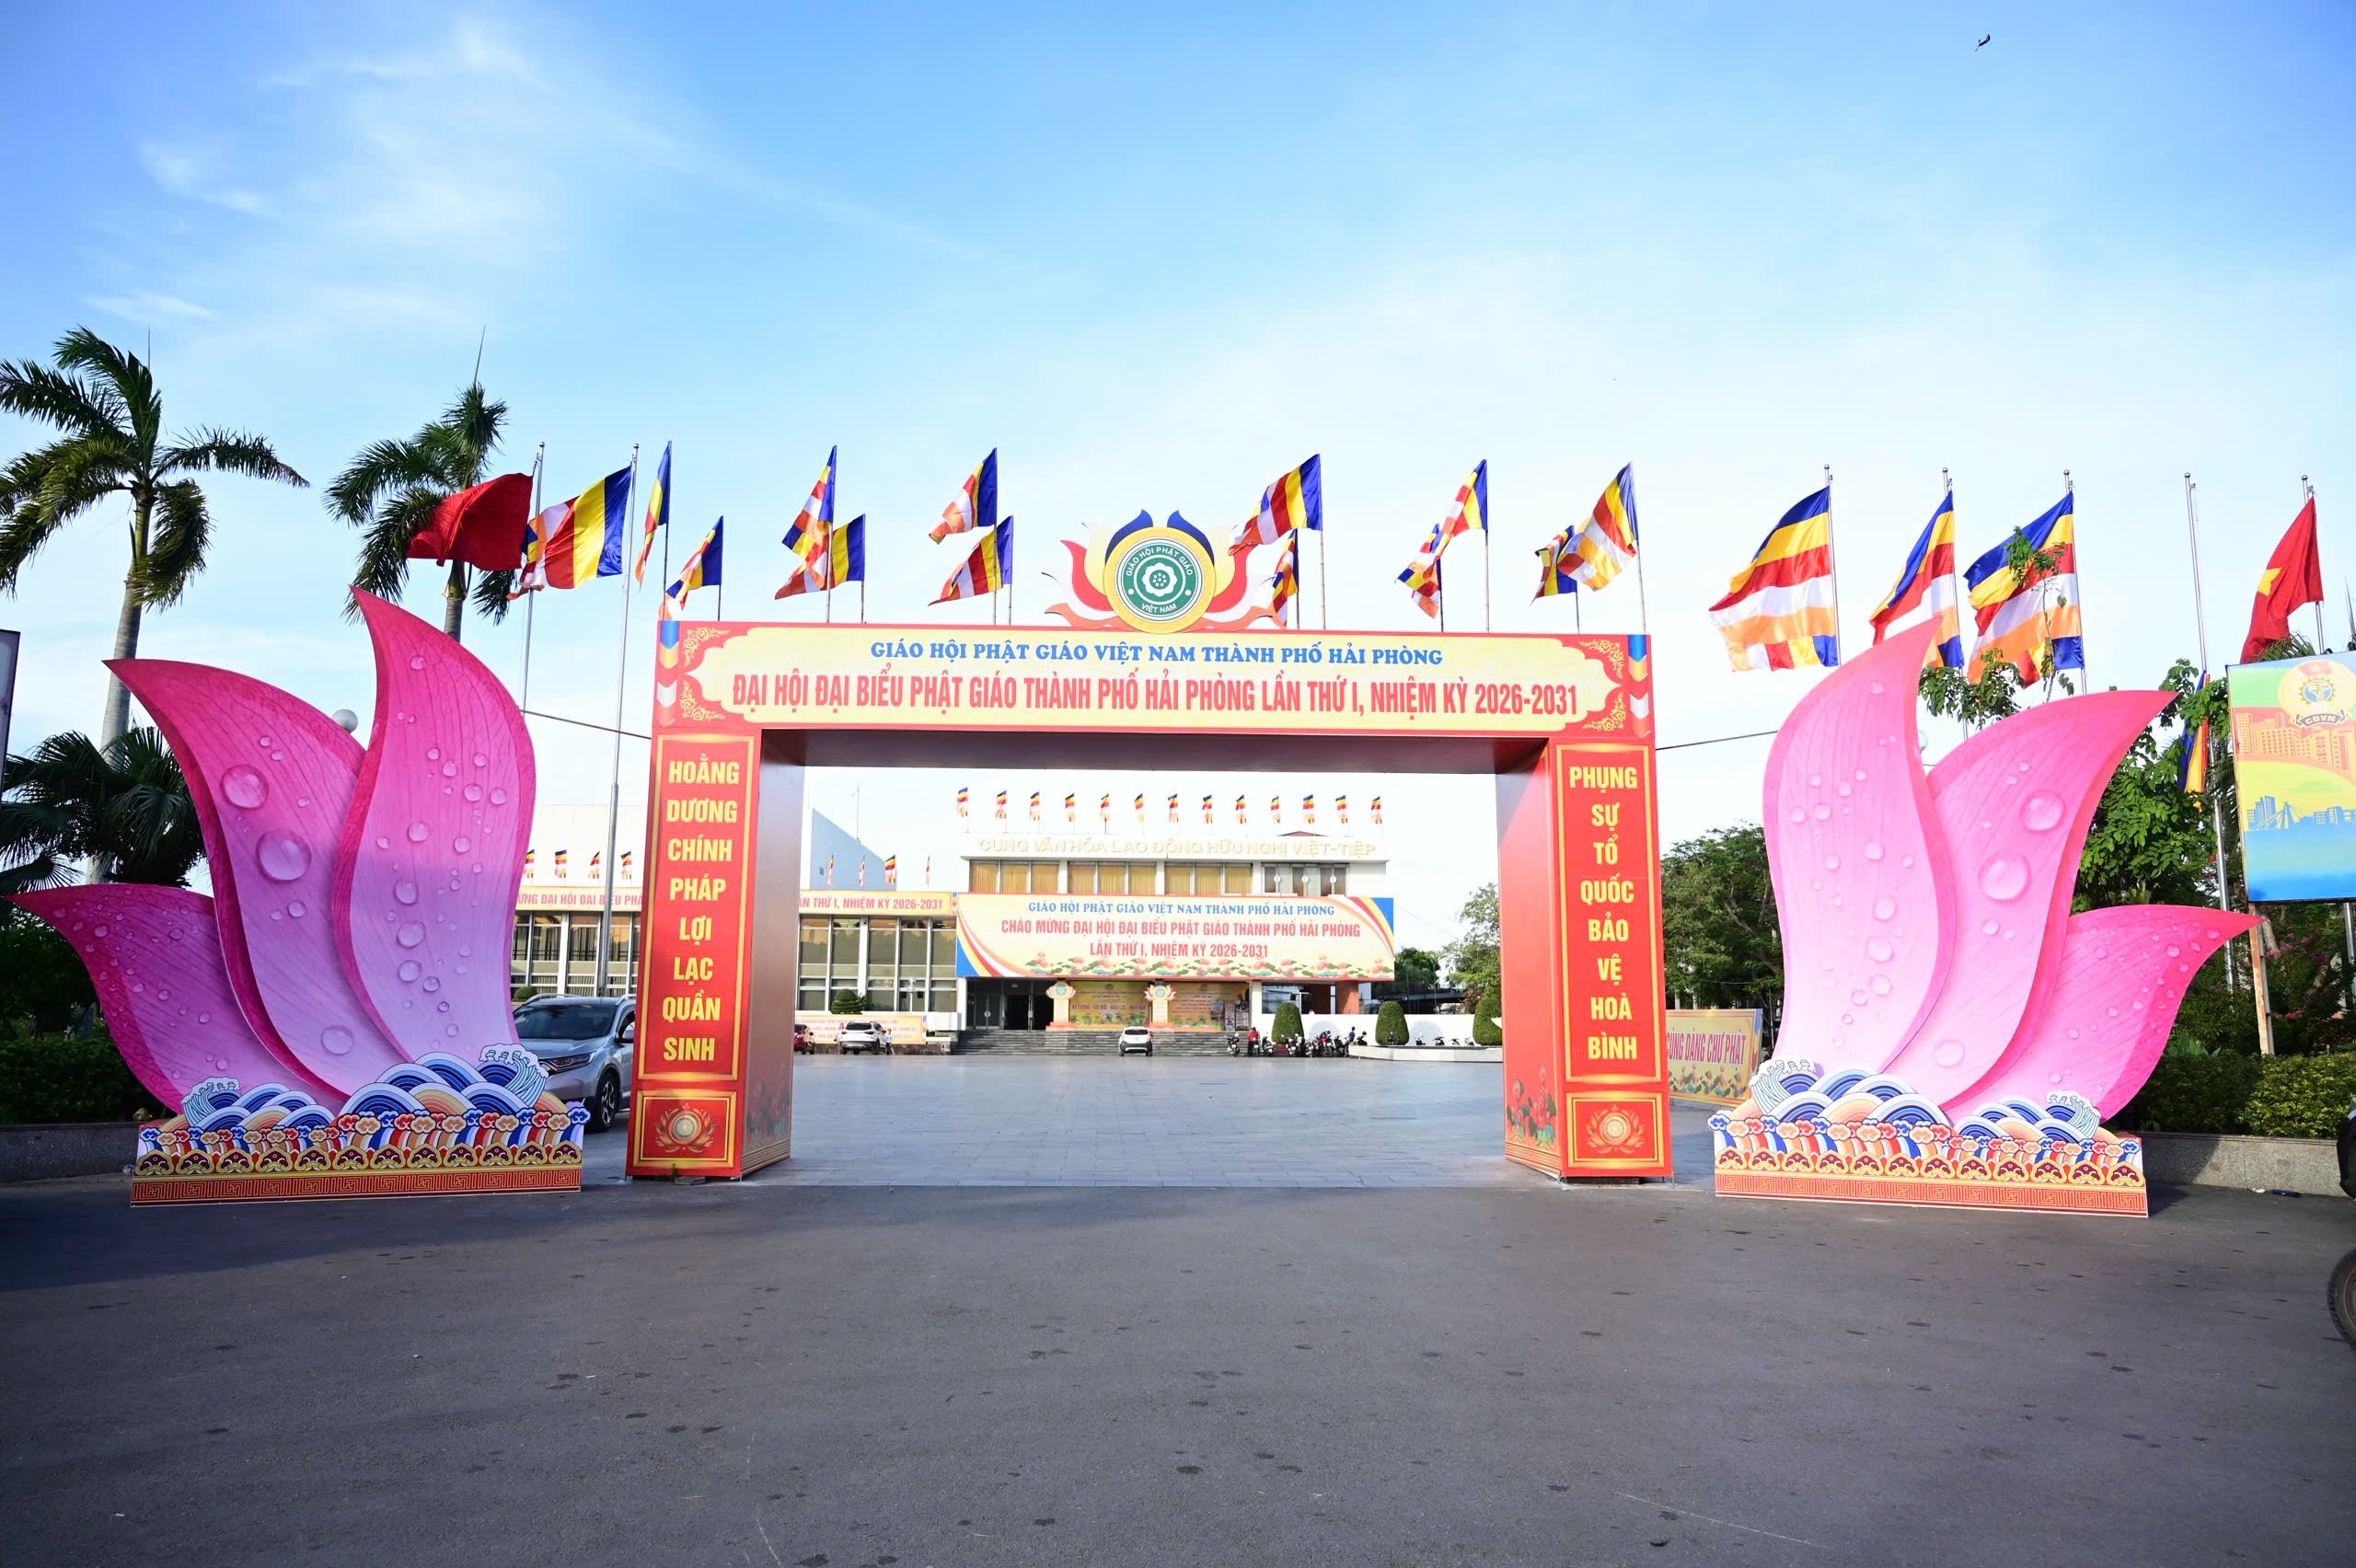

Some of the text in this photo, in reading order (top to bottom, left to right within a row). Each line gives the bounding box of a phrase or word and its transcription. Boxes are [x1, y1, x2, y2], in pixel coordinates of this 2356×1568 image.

[1126, 557, 1139, 576] GIÁO
[1138, 547, 1154, 559] HỘI
[1179, 556, 1194, 575] GIÁO
[1160, 603, 1177, 613] NAM
[871, 638, 1443, 665] GIÁO HỘI PHẬT GIÁO VIỆT NAM THÀNH PHỐ HẢI PHÒNG
[733, 663, 1576, 721] ĐẠI HỘI ĐẠI BIỂU PHẬT GIÁO THÀNH PHỐ HẢI PHÒNG LẦN THỨ I, NHIỆM KỲ 2026-2031
[668, 753, 740, 784] HOẰNG
[1569, 766, 1638, 793] PHỤNG
[666, 798, 737, 823] DƯƠNG
[1591, 802, 1620, 831] SỰ
[667, 834, 733, 861] CHÍNH
[978, 838, 1028, 852] CUNG
[1034, 836, 1067, 853] VĂN
[1069, 836, 1105, 853] HÓA
[1111, 840, 1148, 853] LAO
[1593, 834, 1619, 865] TỔ
[518, 892, 538, 905] ỪNG
[541, 894, 558, 907] ĐẠI
[560, 892, 577, 907] HỘI
[580, 894, 596, 907] ĐẠI
[669, 873, 726, 901] PHÁP
[1580, 872, 1634, 905] QUỐC
[843, 896, 875, 911] NHIỆM
[878, 896, 890, 909] KỲ
[893, 899, 942, 909] 2026-2031
[1028, 900, 1334, 916] GIÁO HỘI PHẬT GIÁO VIỆT NAM THÀNH PHỐ HẢI PHÒNG
[679, 915, 713, 945] LỢI
[1001, 916, 1360, 939] CHÀO MỪNG ĐẠI HỘI ĐẠI BIỂU PHẬT GIÁO THÀNH PHỐ HẢI PHÒNG
[1588, 911, 1629, 942] BẢO
[1090, 938, 1268, 960] LẦN THỨ I, NHIỆM KỲ 2026-2031
[673, 957, 714, 986] LẠC
[1597, 953, 1623, 986] VỆ
[662, 989, 722, 1022] QUẦN
[1590, 992, 1633, 1020] HOÀ
[663, 1036, 715, 1061] SINH
[1588, 1032, 1638, 1060] BÌNH
[1707, 1031, 1725, 1064] CHƯ
[1724, 1028, 1747, 1071] PHẬT
